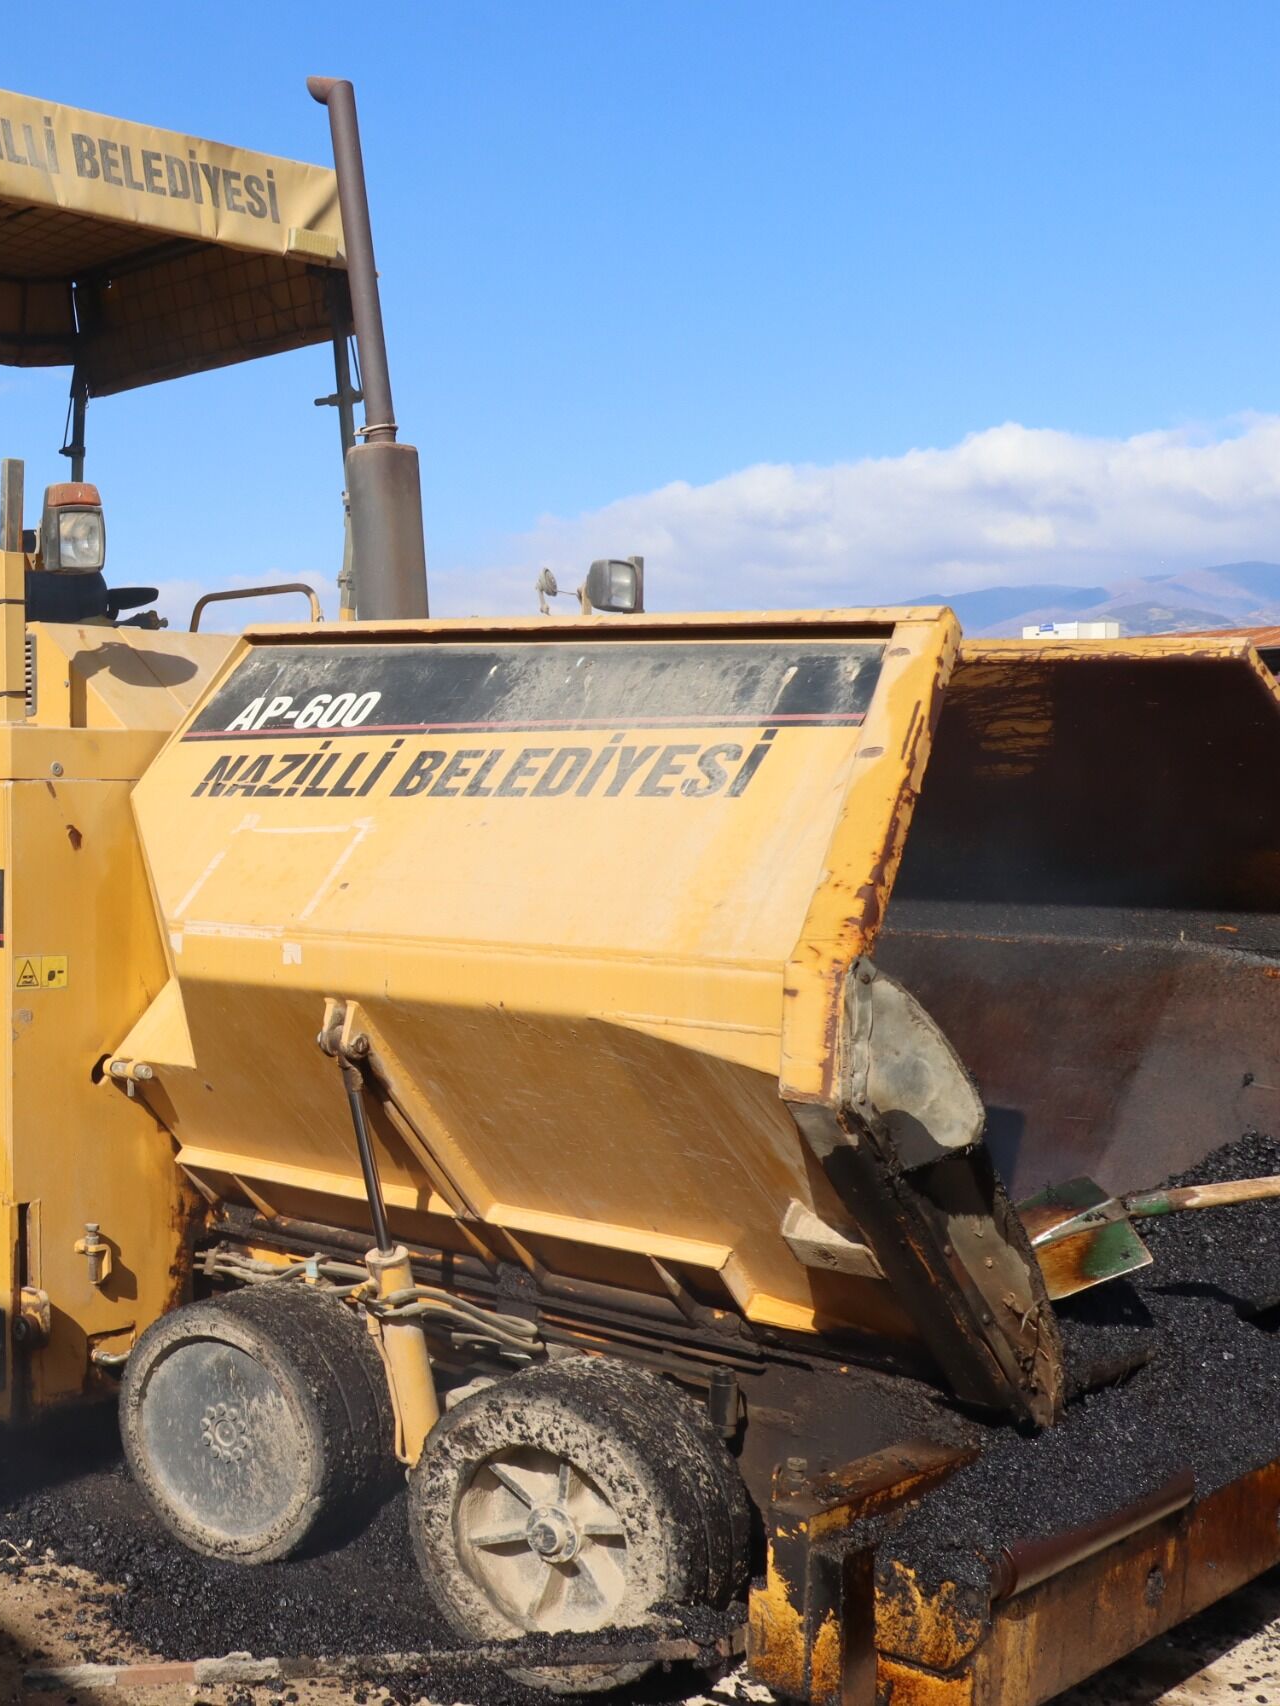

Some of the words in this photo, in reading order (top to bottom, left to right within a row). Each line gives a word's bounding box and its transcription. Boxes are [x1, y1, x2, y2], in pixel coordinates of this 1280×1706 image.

[72, 132, 281, 223] BELEDİYESİ
[225, 692, 382, 730] AP-600
[191, 740, 404, 798] NAZİLLİ
[391, 728, 778, 798] BELEDİYESİ
